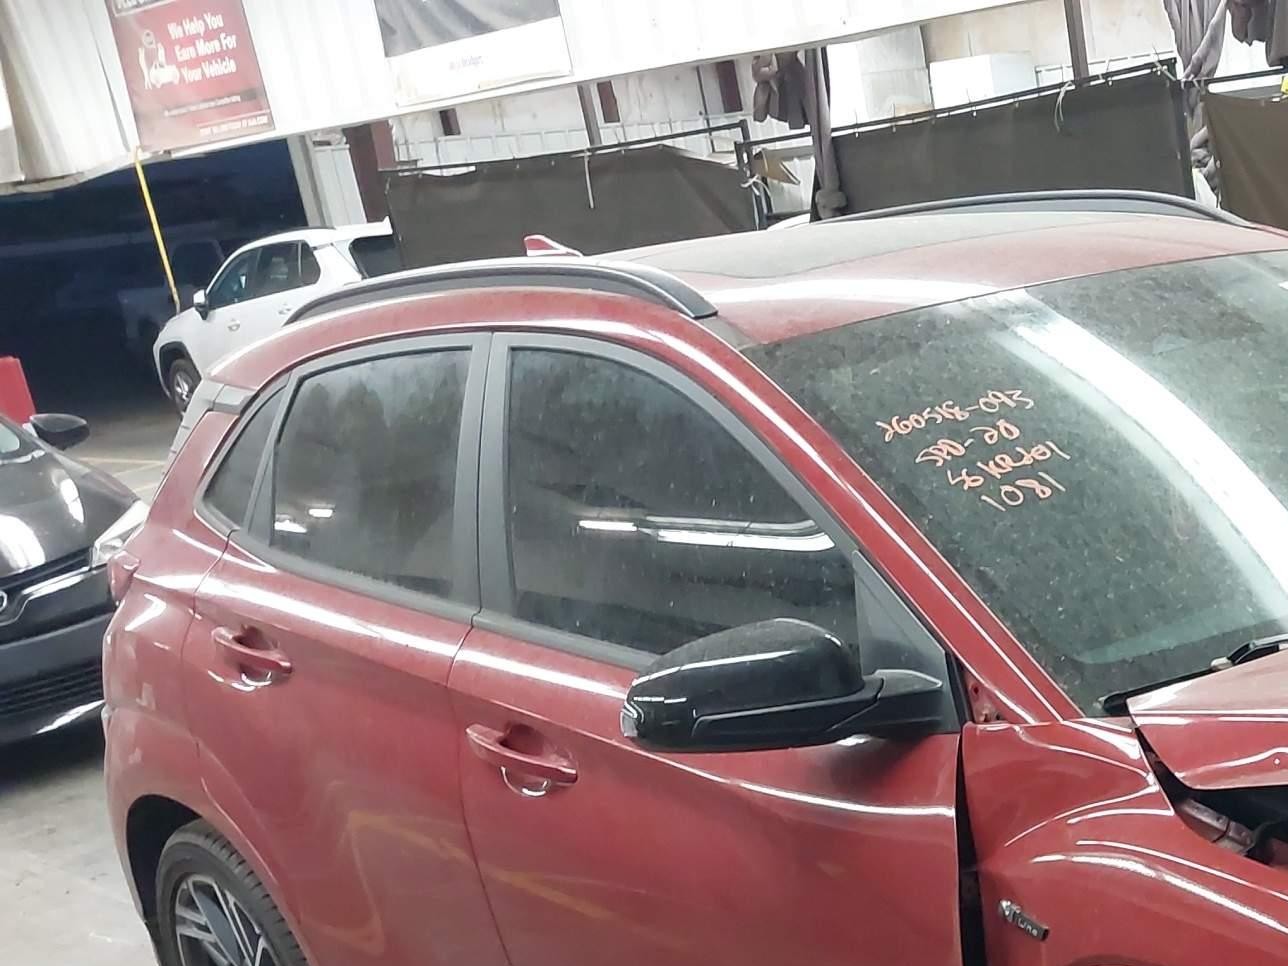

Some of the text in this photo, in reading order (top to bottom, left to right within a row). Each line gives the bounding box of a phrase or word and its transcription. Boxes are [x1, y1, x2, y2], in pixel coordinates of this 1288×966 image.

[167, 12, 224, 40] We Help You
[174, 33, 237, 62] Earn More For
[180, 57, 237, 83] Your Vehicle
[981, 471, 1066, 512] 1081
